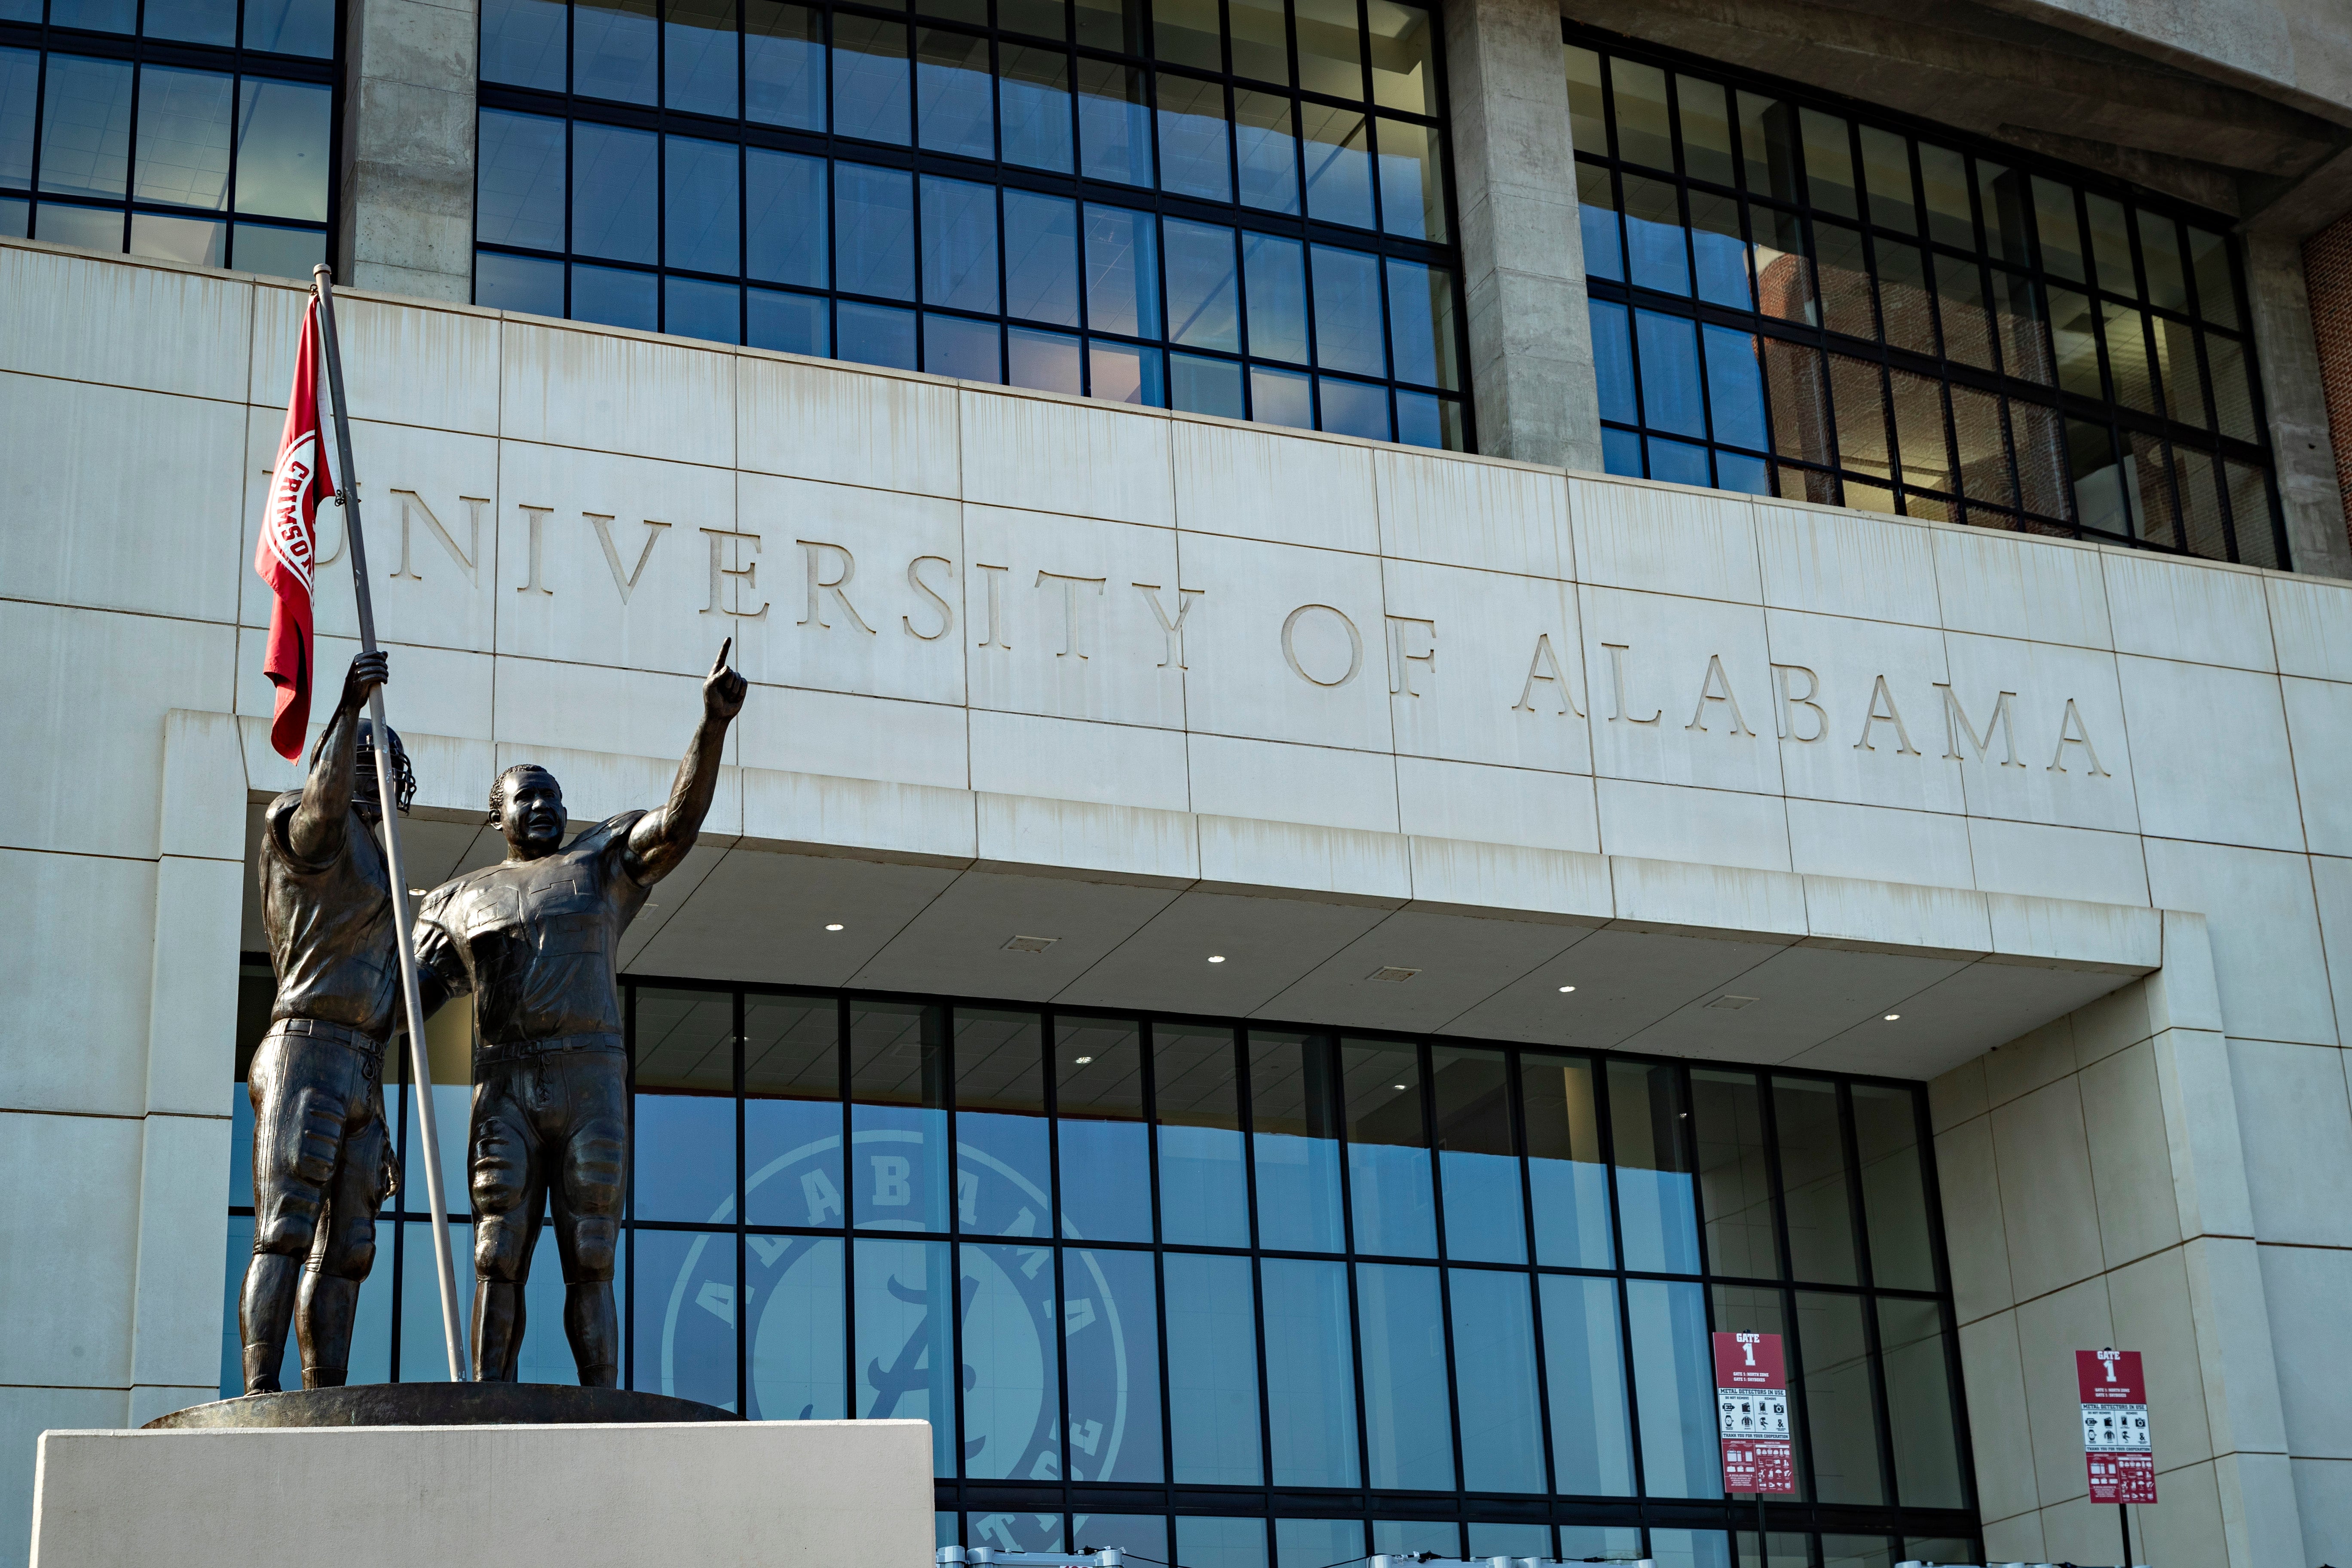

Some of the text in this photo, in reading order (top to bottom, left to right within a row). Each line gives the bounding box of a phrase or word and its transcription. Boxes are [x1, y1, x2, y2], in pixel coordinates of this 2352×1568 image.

[1281, 603, 1436, 698] OF
[1512, 633, 2111, 777] ALABAMA
[1736, 1333, 1760, 1343] GATE
[1742, 1343, 1756, 1366] 1
[2097, 1351, 2121, 1360] GATE
[2103, 1360, 2117, 1382] 1
